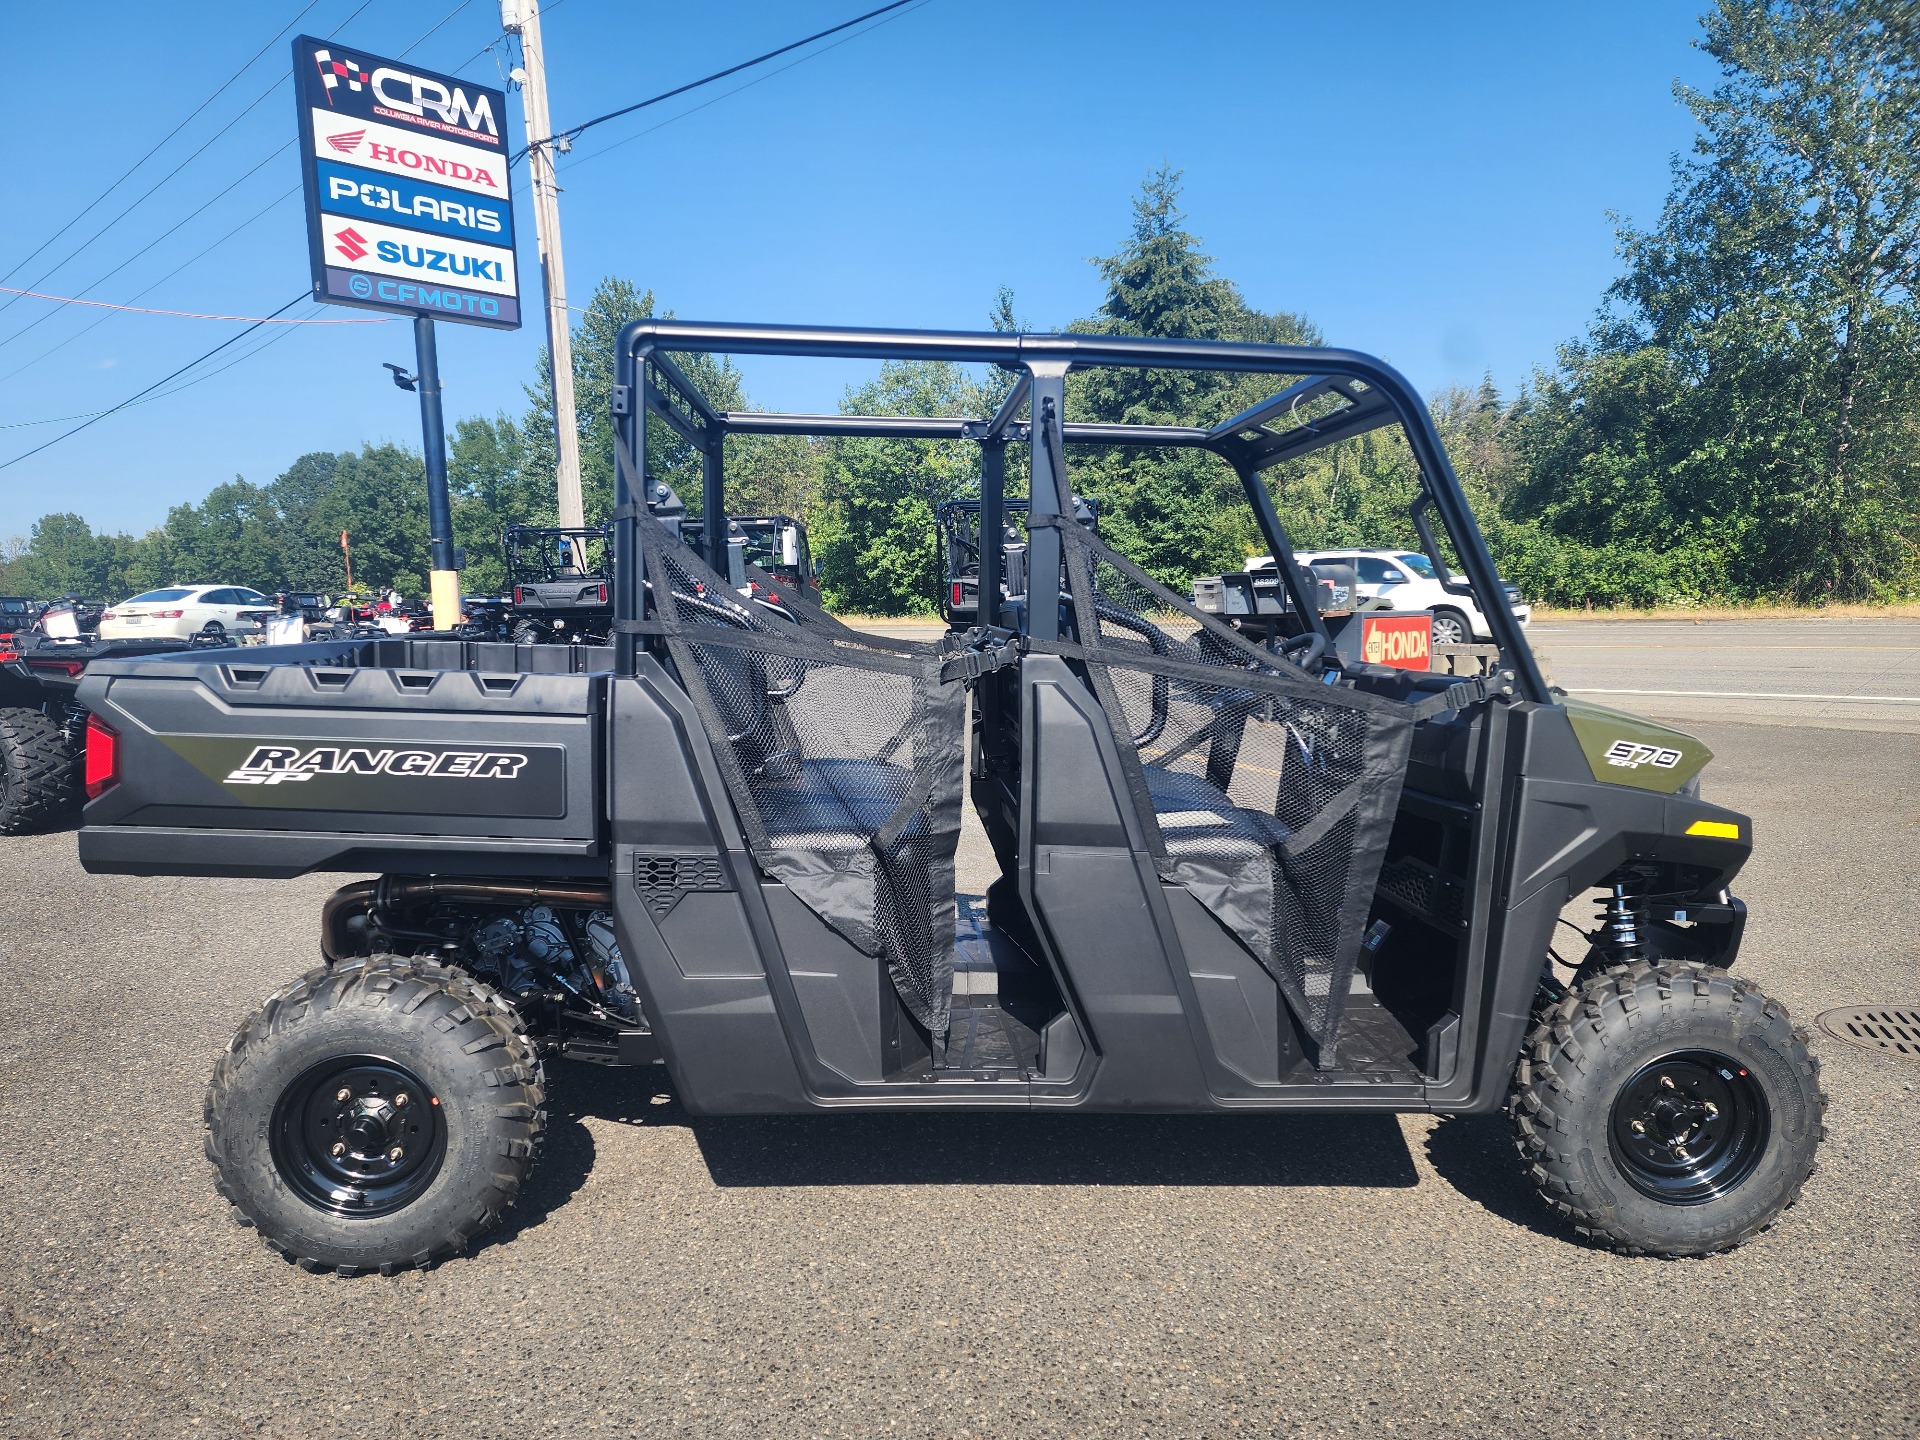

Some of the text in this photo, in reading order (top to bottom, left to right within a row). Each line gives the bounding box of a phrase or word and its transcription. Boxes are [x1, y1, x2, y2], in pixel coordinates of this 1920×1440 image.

[371, 67, 498, 135] CRM
[373, 106, 499, 145] COLUMBIA RIVER MOTORSPORTS
[368, 141, 498, 188] HONDA
[329, 176, 502, 233] POLARIS
[376, 240, 504, 282] SUZUKI
[378, 280, 499, 316] CFMOTO
[1381, 630, 1429, 661] HONDA
[240, 746, 528, 778] RANGER
[1603, 740, 1683, 769] 570
[223, 770, 315, 785] SP
